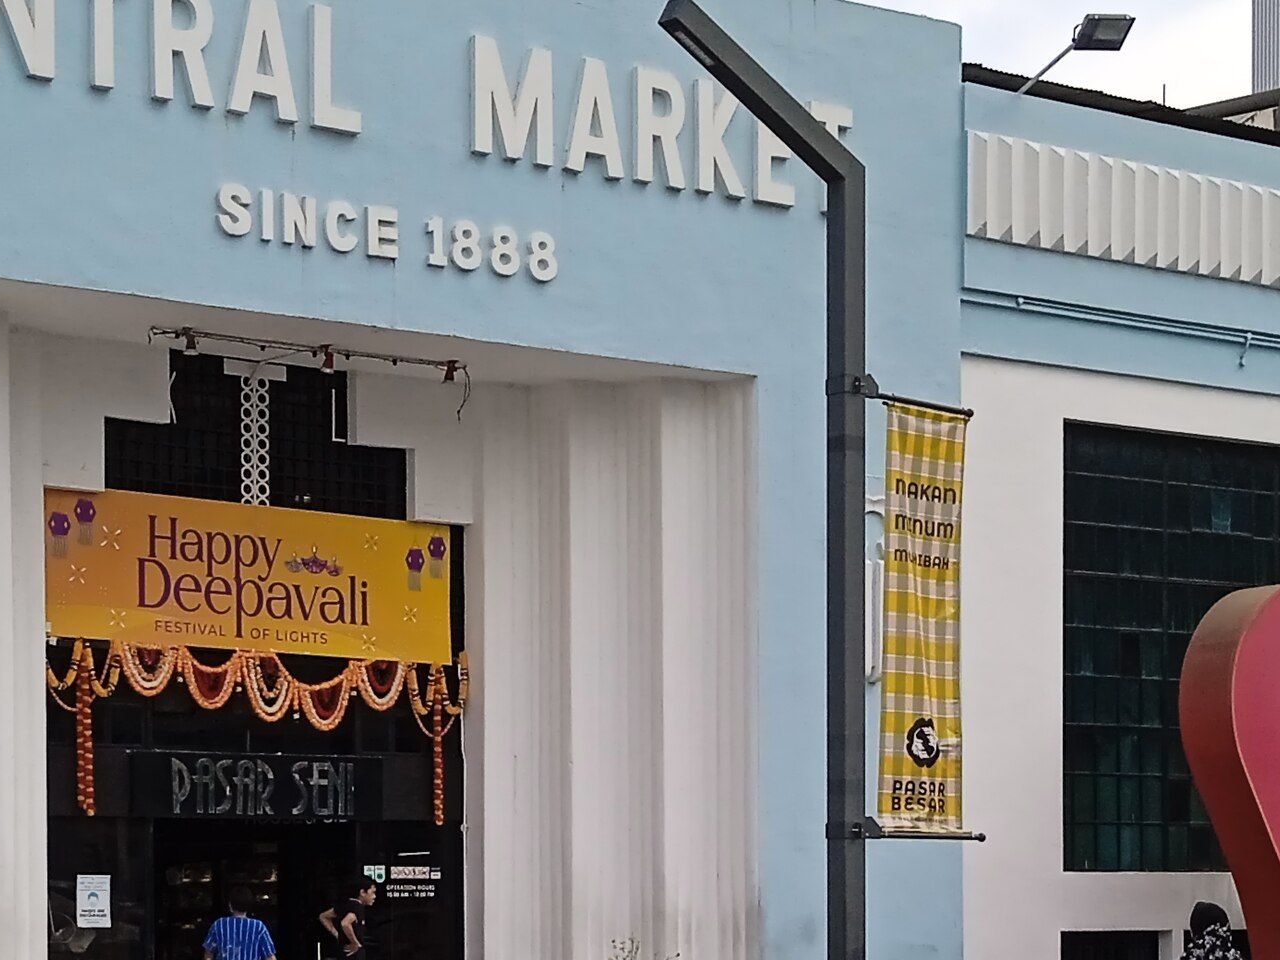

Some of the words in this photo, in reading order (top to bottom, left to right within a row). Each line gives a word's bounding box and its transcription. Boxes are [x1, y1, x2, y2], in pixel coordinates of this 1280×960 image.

[216, 183, 399, 260] SINCE
[425, 216, 558, 282] 1888
[147, 514, 283, 582] Happy
[136, 557, 369, 638] Deepavali
[154, 619, 226, 637] FESTIVAL
[250, 627, 270, 640] OF
[276, 629, 328, 645] LIGHTS
[171, 757, 274, 815] PASAR
[291, 760, 355, 816] SENI
[891, 796, 946, 813] BESAR
[892, 780, 946, 797] PASAR
